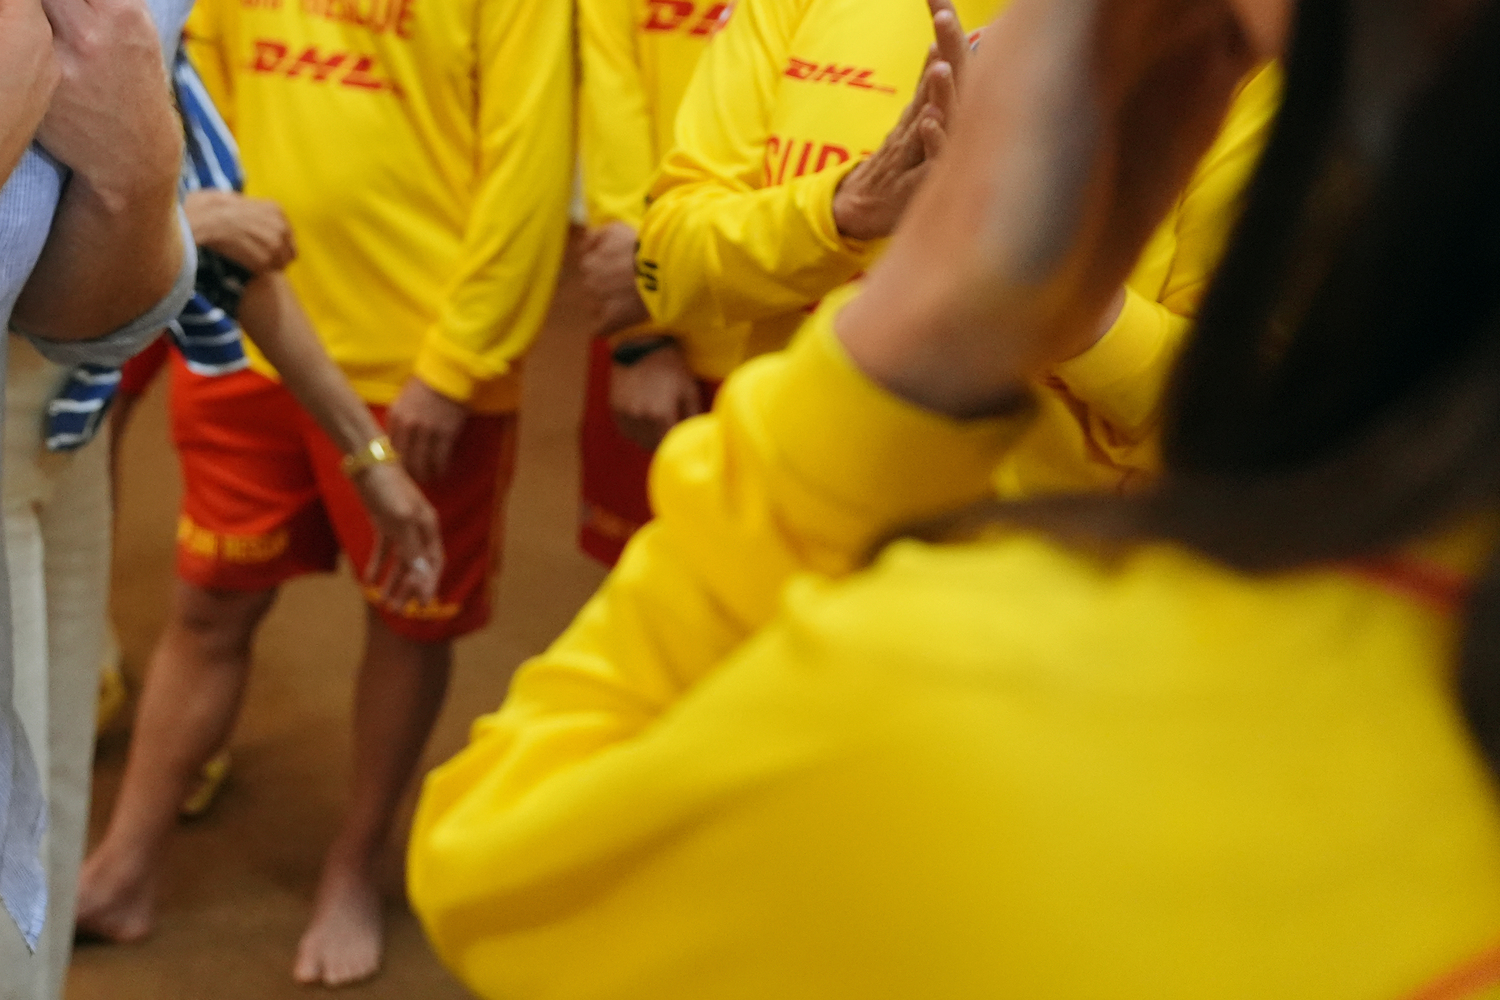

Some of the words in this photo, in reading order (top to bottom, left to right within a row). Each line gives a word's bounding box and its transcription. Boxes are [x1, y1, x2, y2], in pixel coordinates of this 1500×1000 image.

[252, 39, 385, 90] DHL
[784, 56, 878, 91] DHL
[765, 133, 866, 188] SUR
